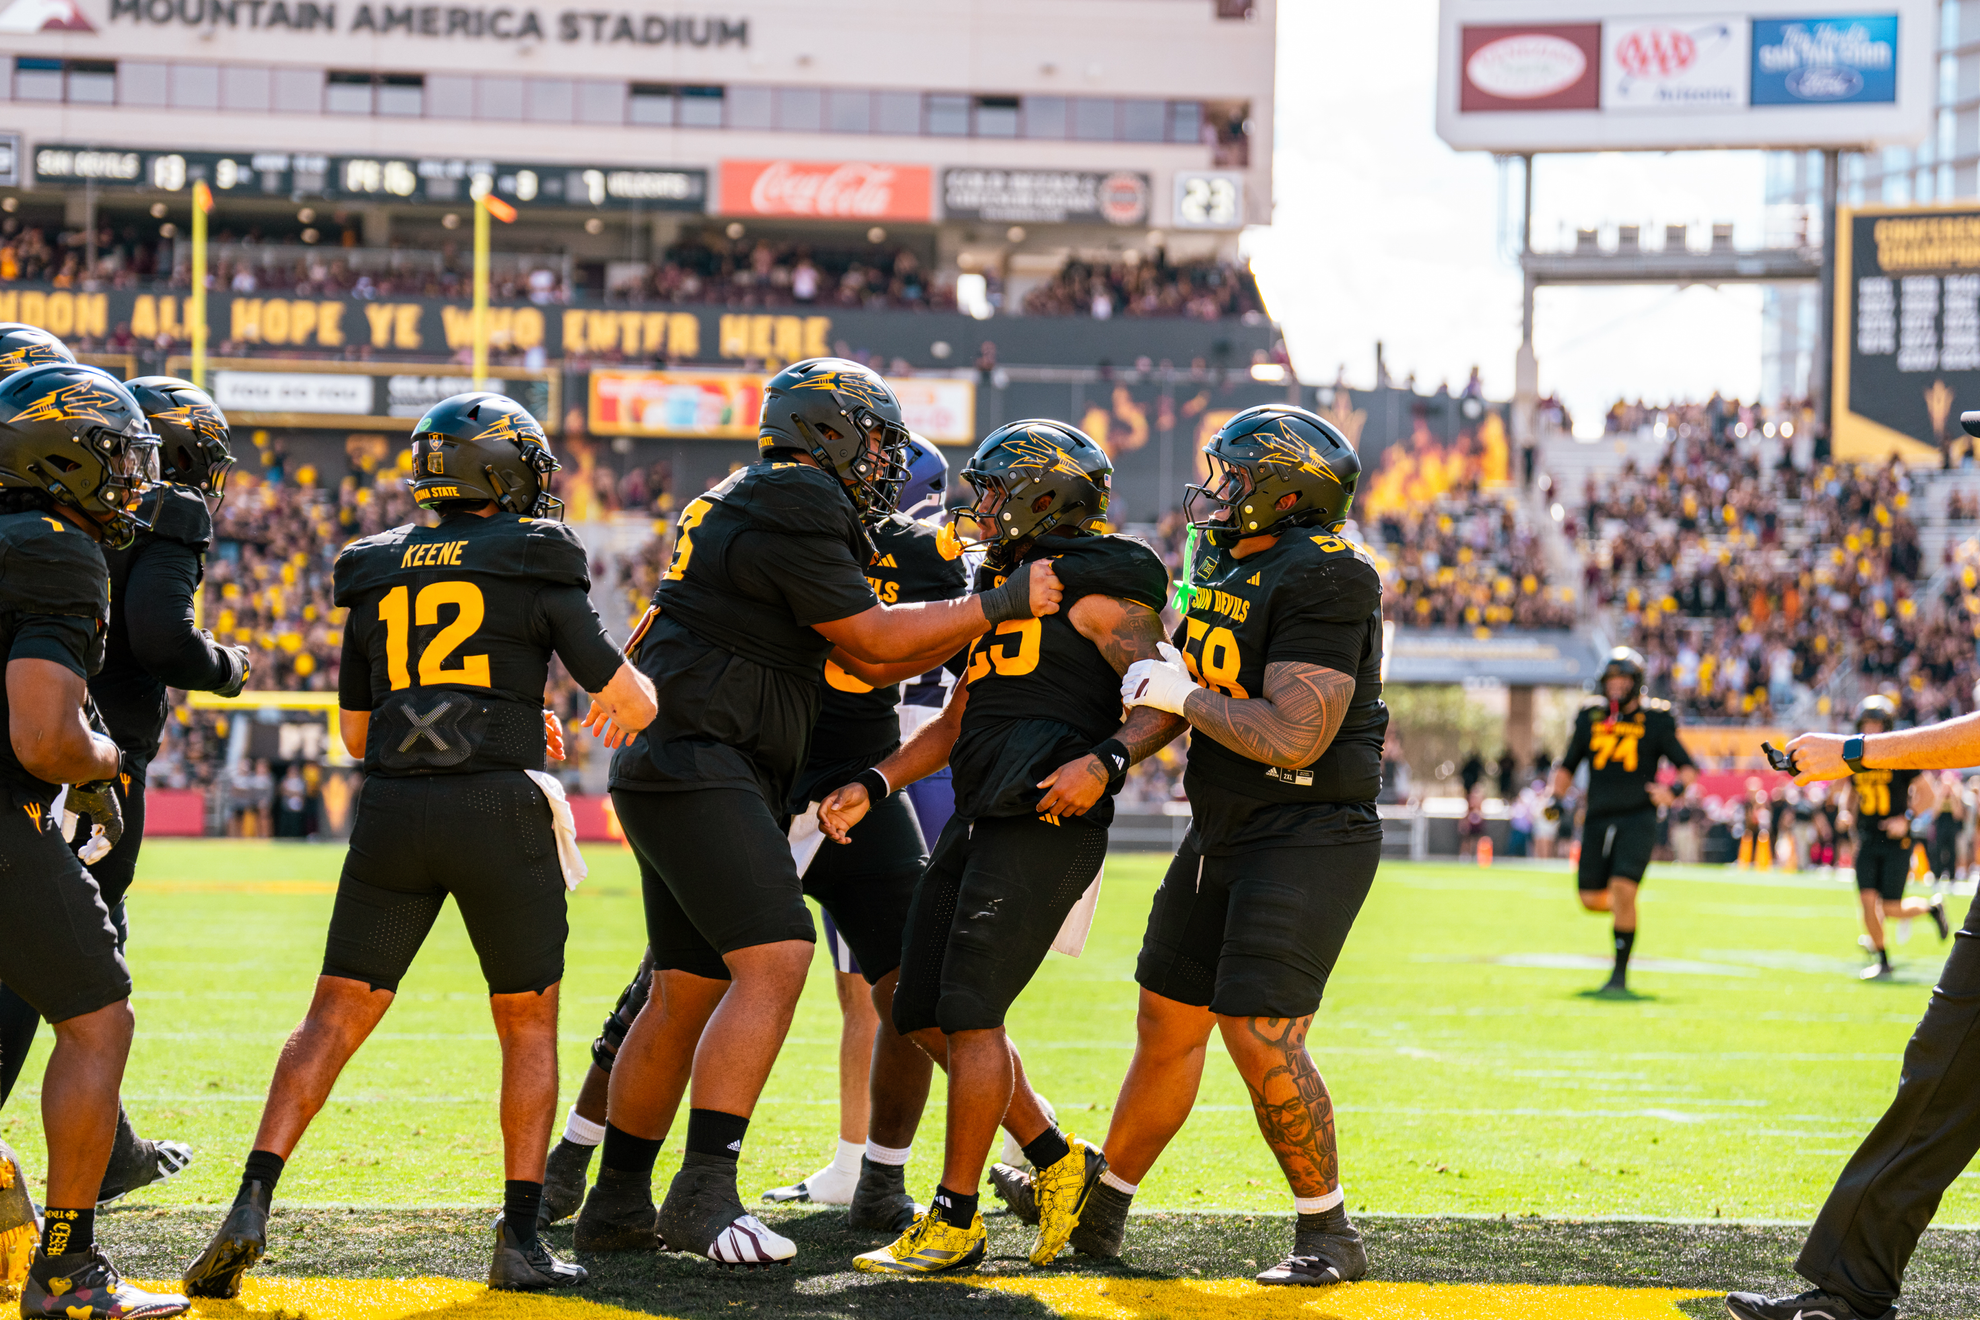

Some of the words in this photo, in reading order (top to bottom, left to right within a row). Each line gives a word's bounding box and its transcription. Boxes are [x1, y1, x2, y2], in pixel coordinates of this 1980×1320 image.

[109, 0, 335, 31] MOUNTAIN
[351, 4, 544, 41] AMERICA
[558, 10, 749, 47] STADIUM
[231, 298, 346, 347] HOPE
[364, 303, 424, 350] YE
[441, 305, 545, 350] WHO
[562, 308, 700, 358] ENTER
[719, 313, 832, 359] HERE
[759, 436, 775, 448] STATE
[431, 486, 461, 497] STATE
[401, 540, 469, 569] KEENE
[1191, 586, 1212, 611] SUN
[1214, 588, 1250, 624] DEVILS
[378, 580, 492, 692] 12
[1182, 616, 1250, 699] 58
[1589, 734, 1639, 773] 74
